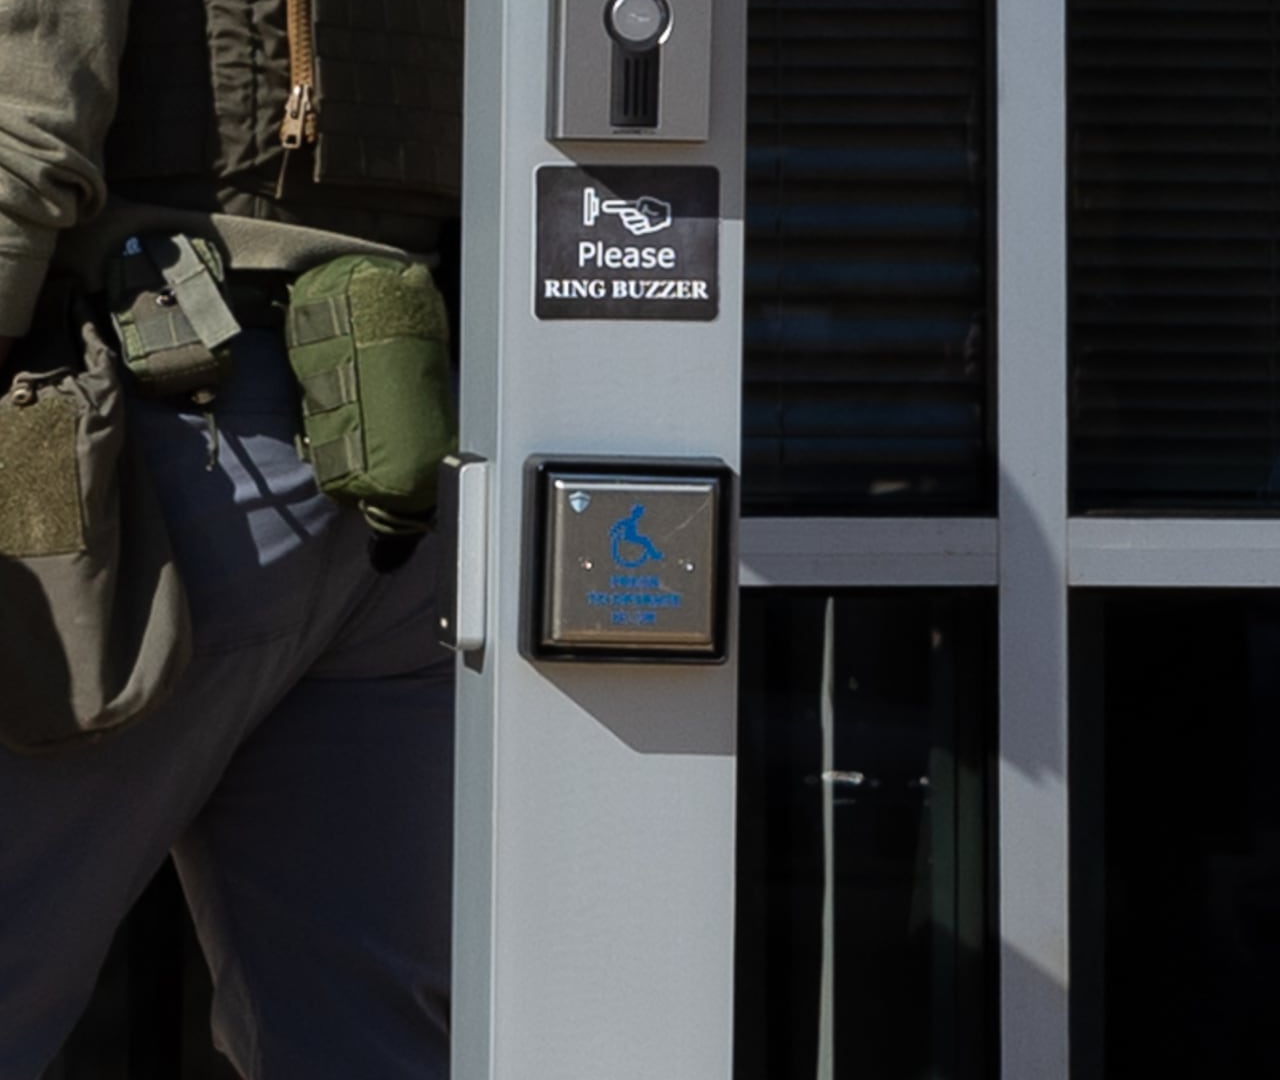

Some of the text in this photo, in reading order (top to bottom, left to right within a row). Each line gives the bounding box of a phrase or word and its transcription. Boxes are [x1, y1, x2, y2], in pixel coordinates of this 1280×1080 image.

[577, 240, 676, 269] Please
[543, 278, 710, 301] RING BUZZER
